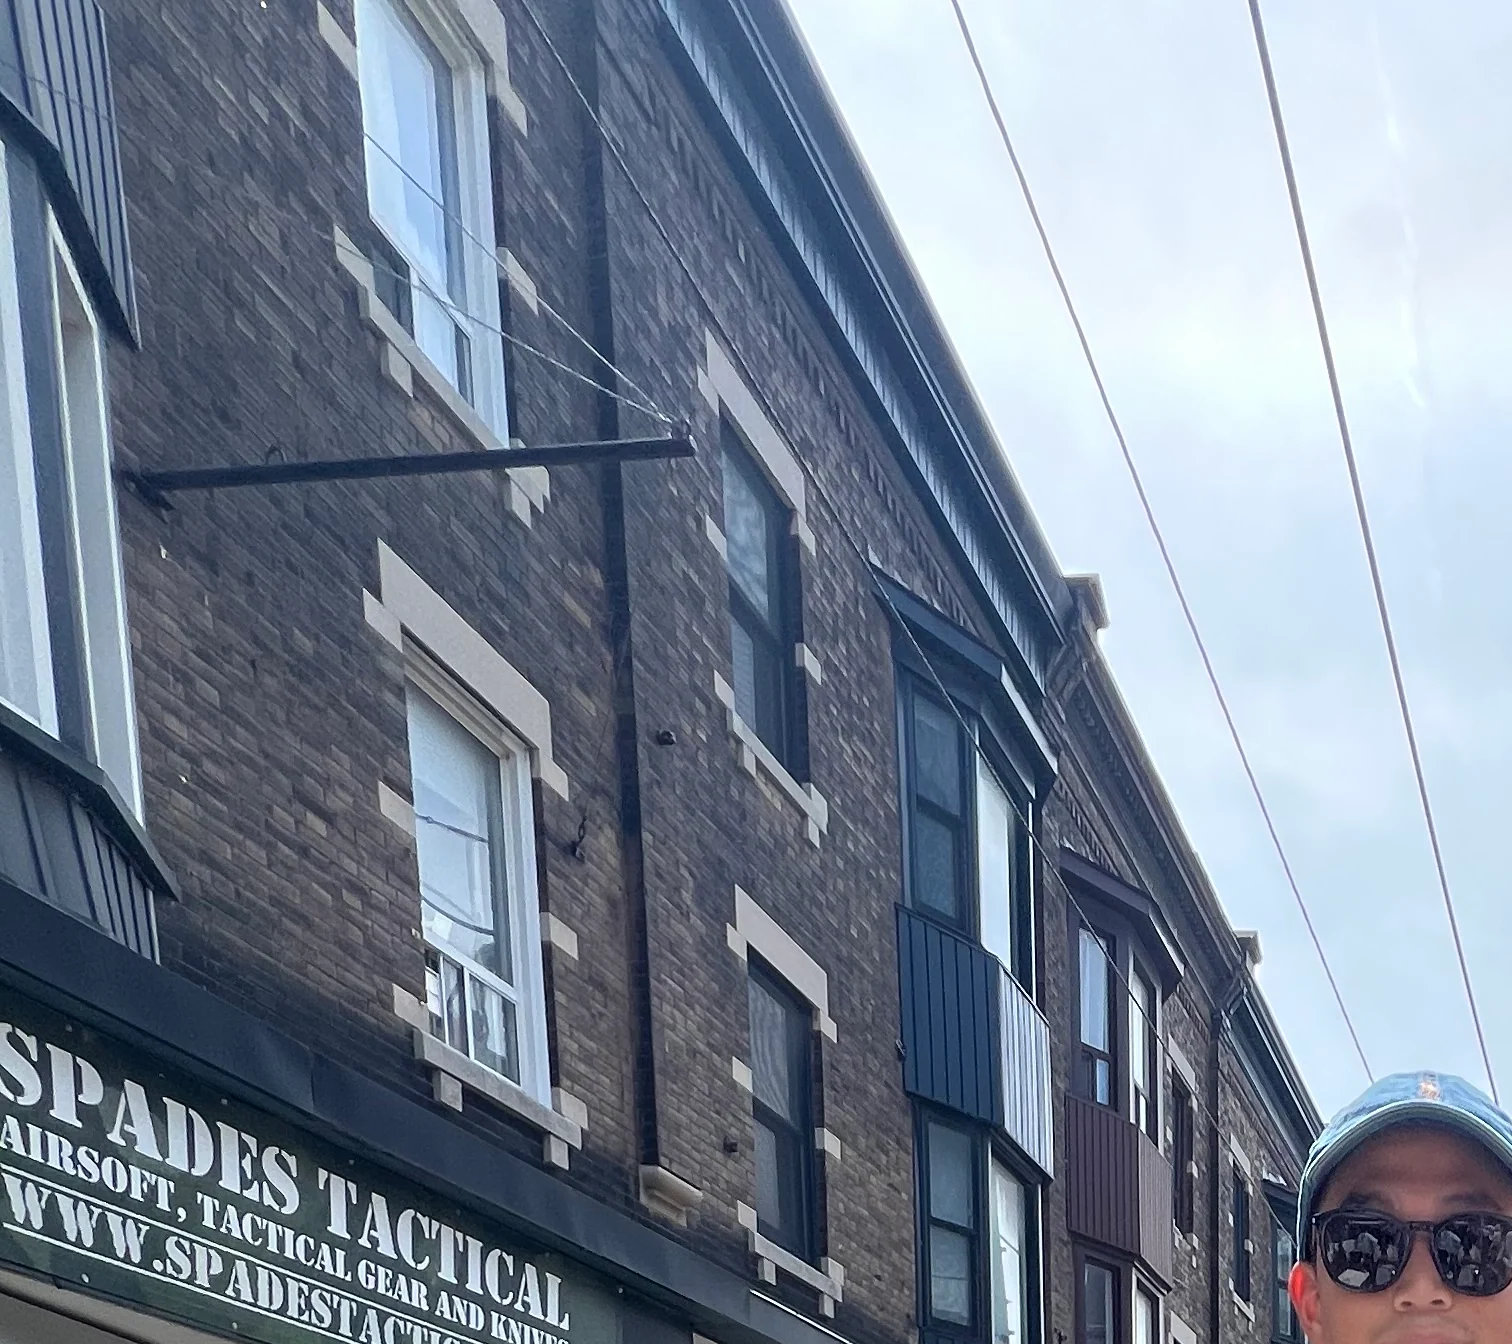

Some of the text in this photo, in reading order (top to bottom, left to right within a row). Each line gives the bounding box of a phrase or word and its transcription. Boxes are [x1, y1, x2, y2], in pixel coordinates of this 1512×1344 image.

[0, 1022, 569, 1331] SPADES TACTICAL
[0, 1114, 187, 1222] AIRSOFT,
[196, 1192, 351, 1282] TACTICAL
[357, 1259, 429, 1311] GEAR
[435, 1291, 485, 1331] AND
